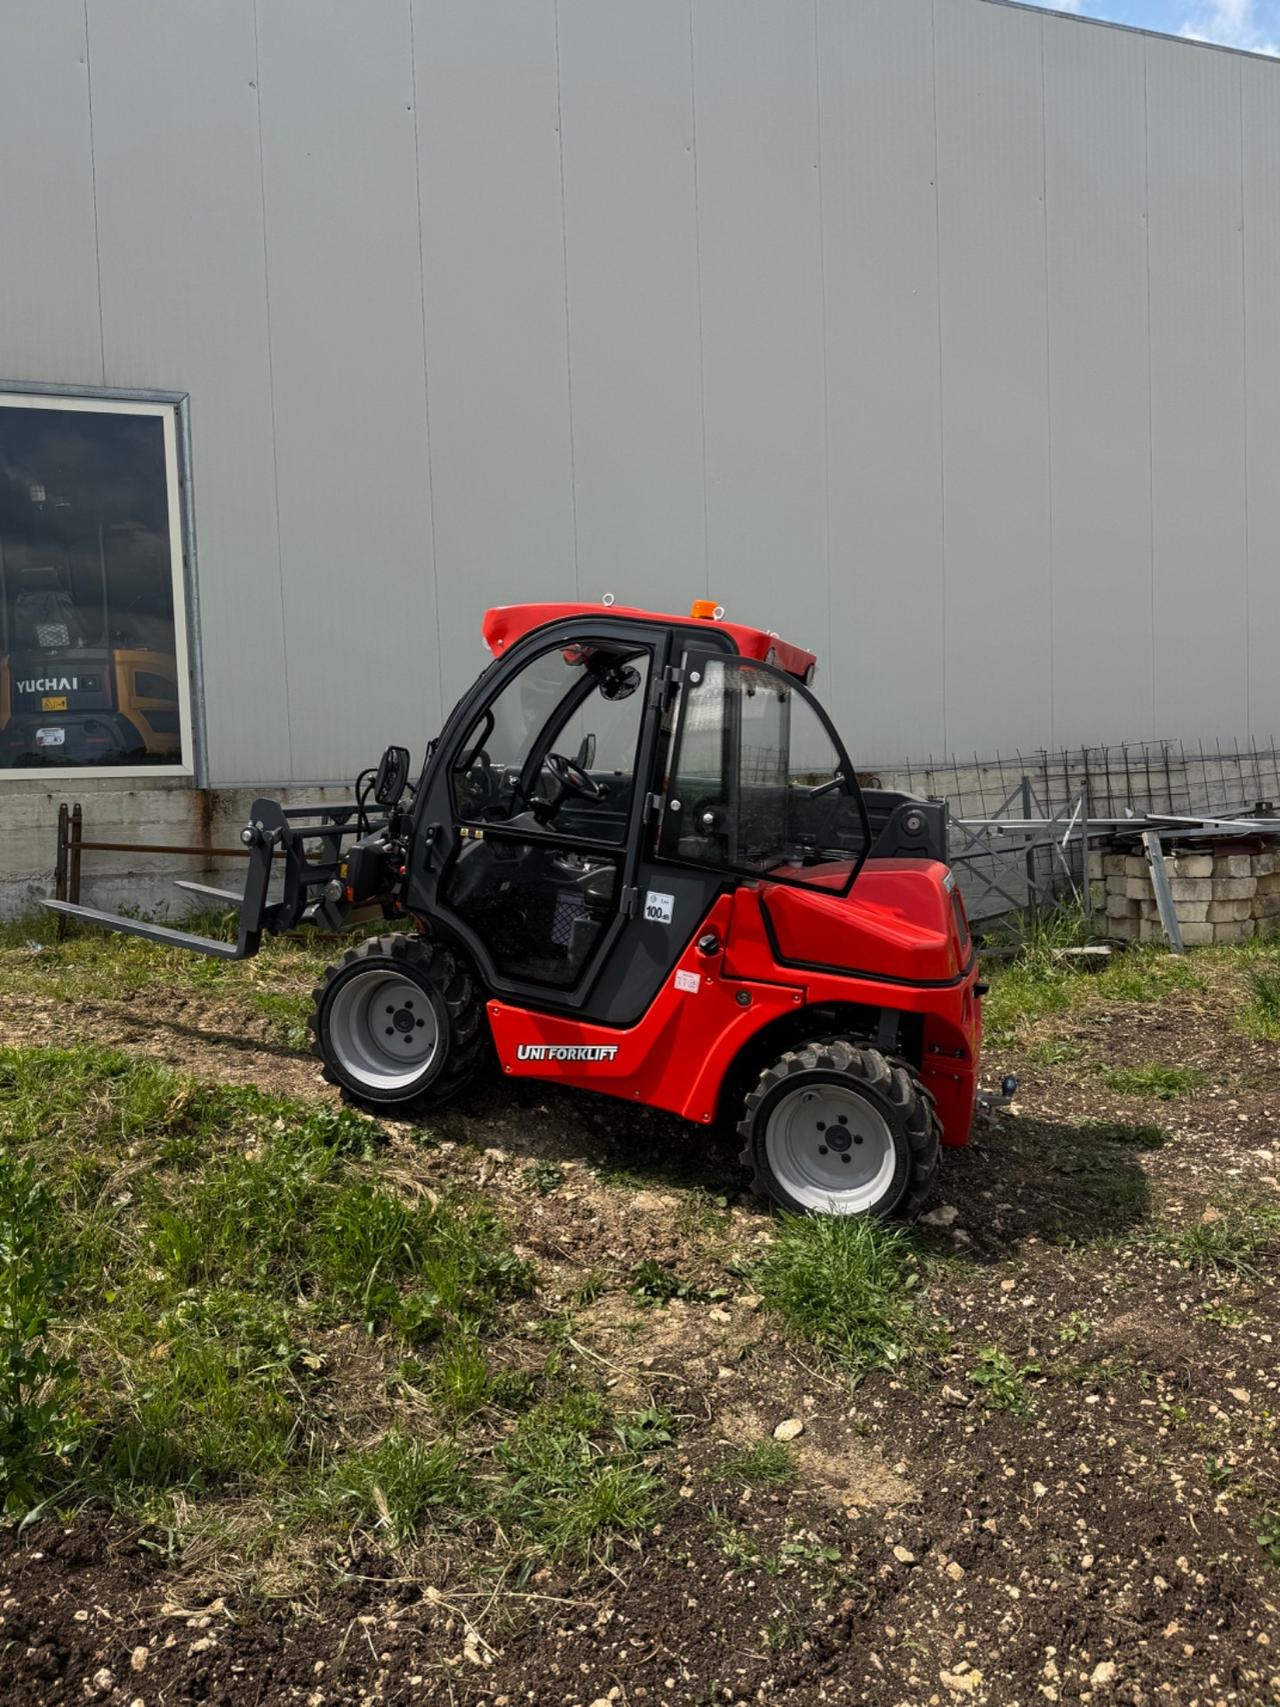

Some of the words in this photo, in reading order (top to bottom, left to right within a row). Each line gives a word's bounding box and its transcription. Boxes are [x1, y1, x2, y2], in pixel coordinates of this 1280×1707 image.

[16, 677, 78, 694] YUCHAI
[646, 905, 663, 919] 100
[517, 1045, 546, 1060] UNI
[548, 1045, 619, 1061] FORKLIFT
